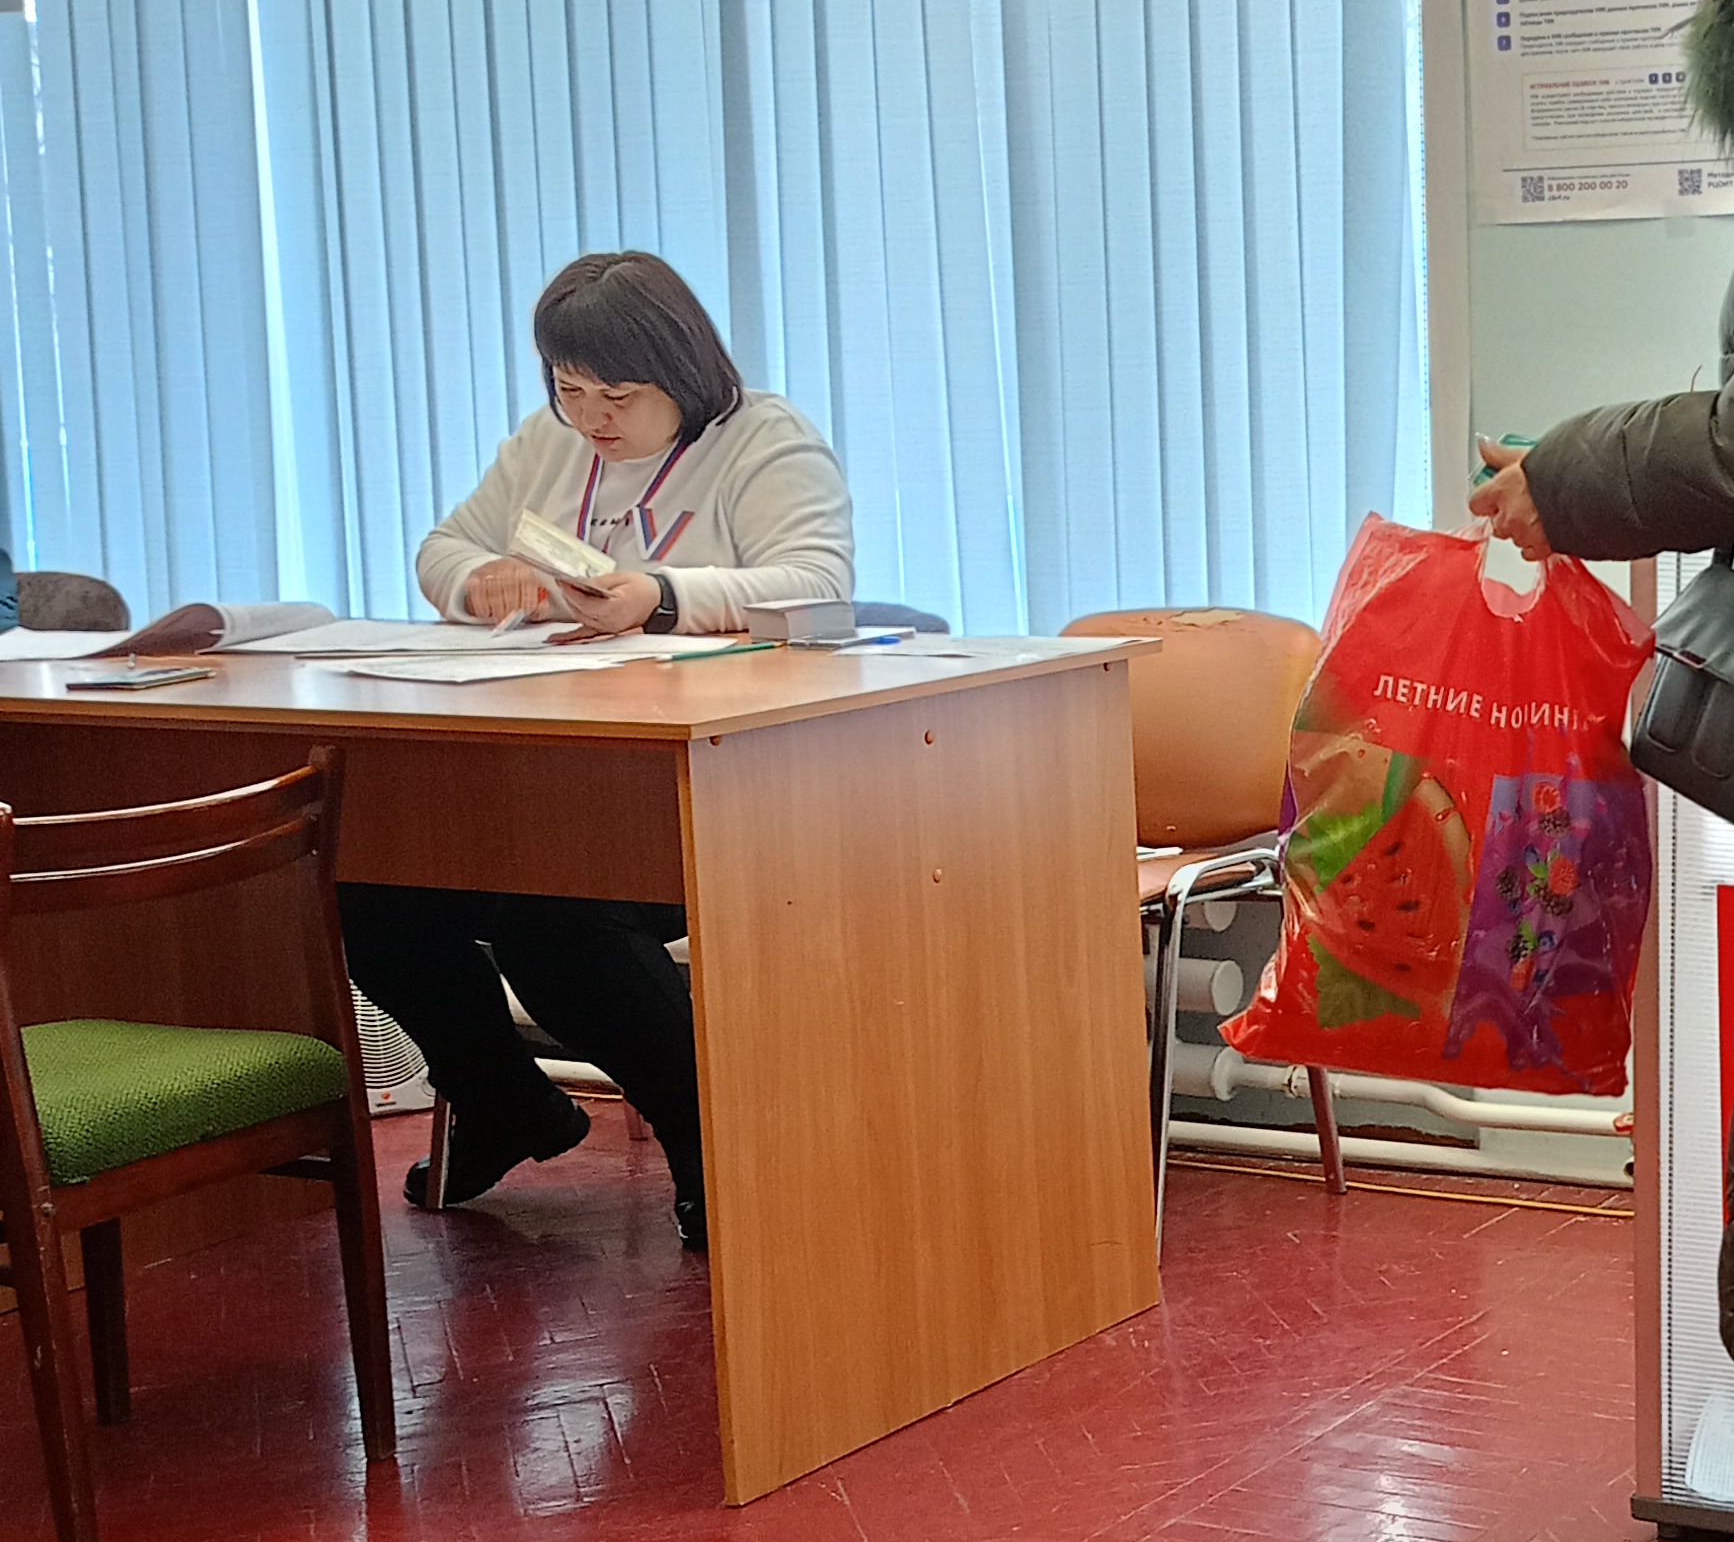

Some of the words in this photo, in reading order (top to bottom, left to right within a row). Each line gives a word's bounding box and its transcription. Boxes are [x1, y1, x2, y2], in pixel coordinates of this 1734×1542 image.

[1556, 182, 1575, 192] 800
[1578, 181, 1597, 191] 200
[1599, 181, 1613, 190] 00
[1615, 180, 1628, 190] 20
[1374, 675, 1483, 718] ЛЕТНИЕ
